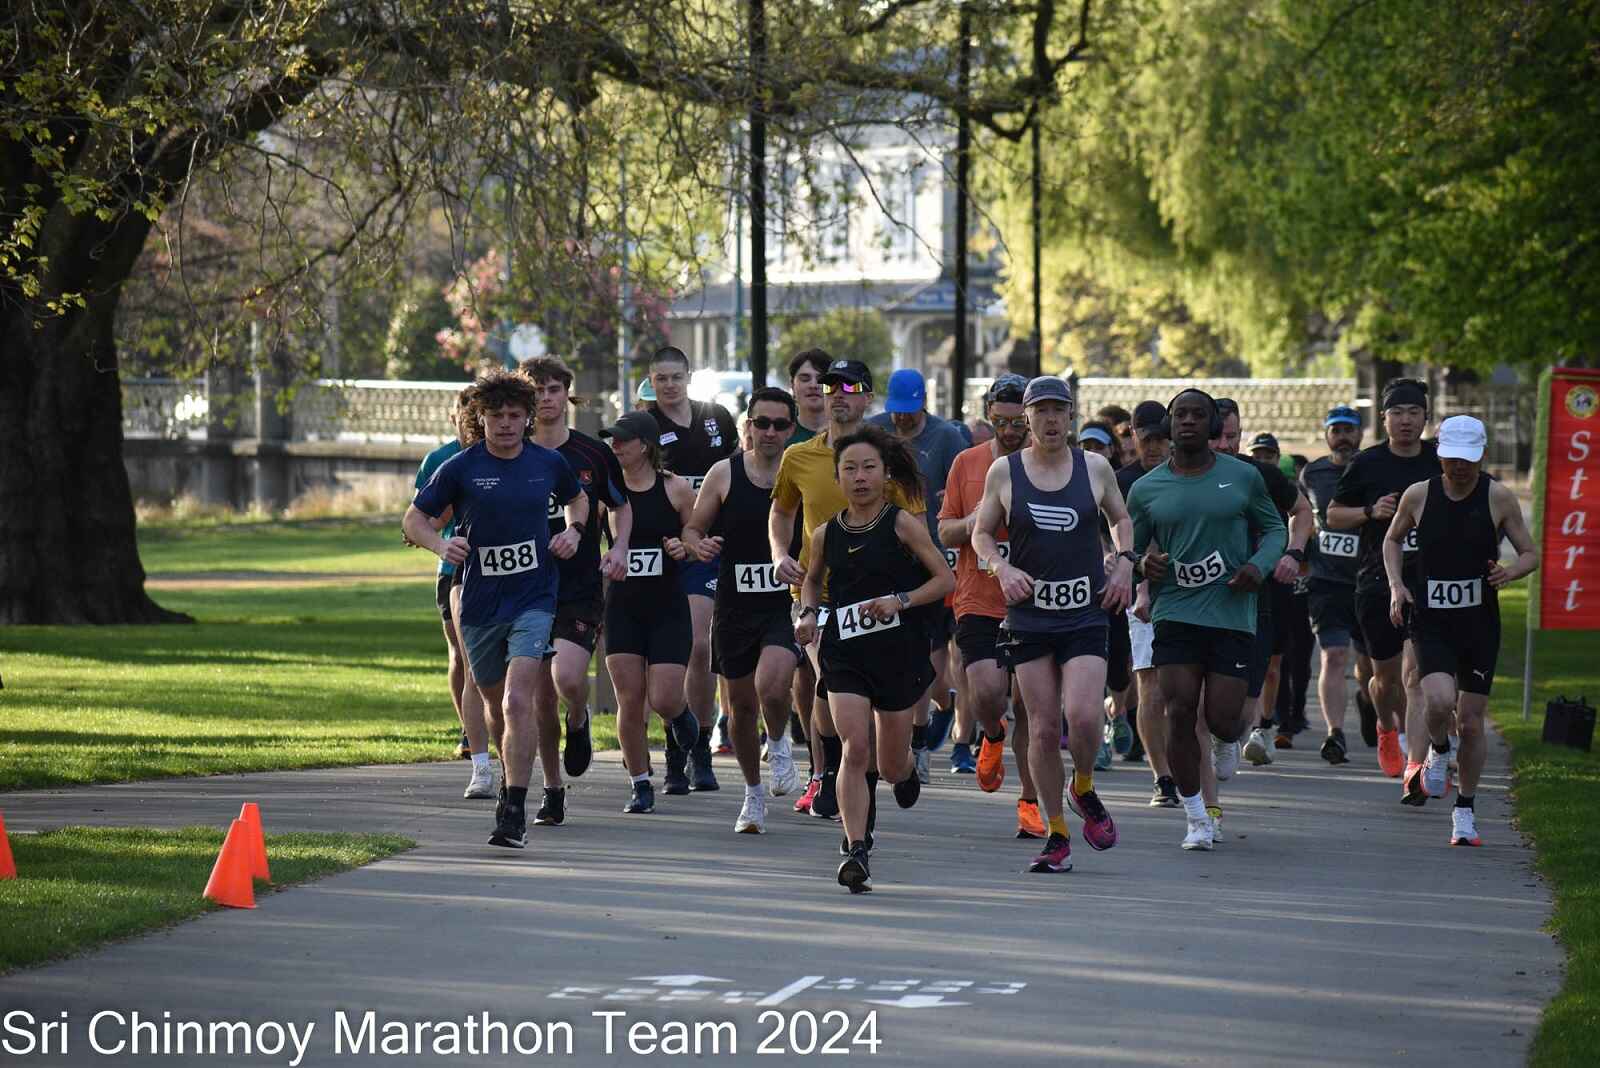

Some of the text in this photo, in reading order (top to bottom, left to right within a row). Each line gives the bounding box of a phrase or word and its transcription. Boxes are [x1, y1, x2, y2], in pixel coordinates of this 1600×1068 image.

[1562, 430, 1592, 611] Start
[1322, 534, 1356, 554] 478
[484, 544, 535, 572] 488
[1178, 555, 1223, 586] 495
[1037, 580, 1088, 607] 486
[1431, 581, 1475, 605] 401
